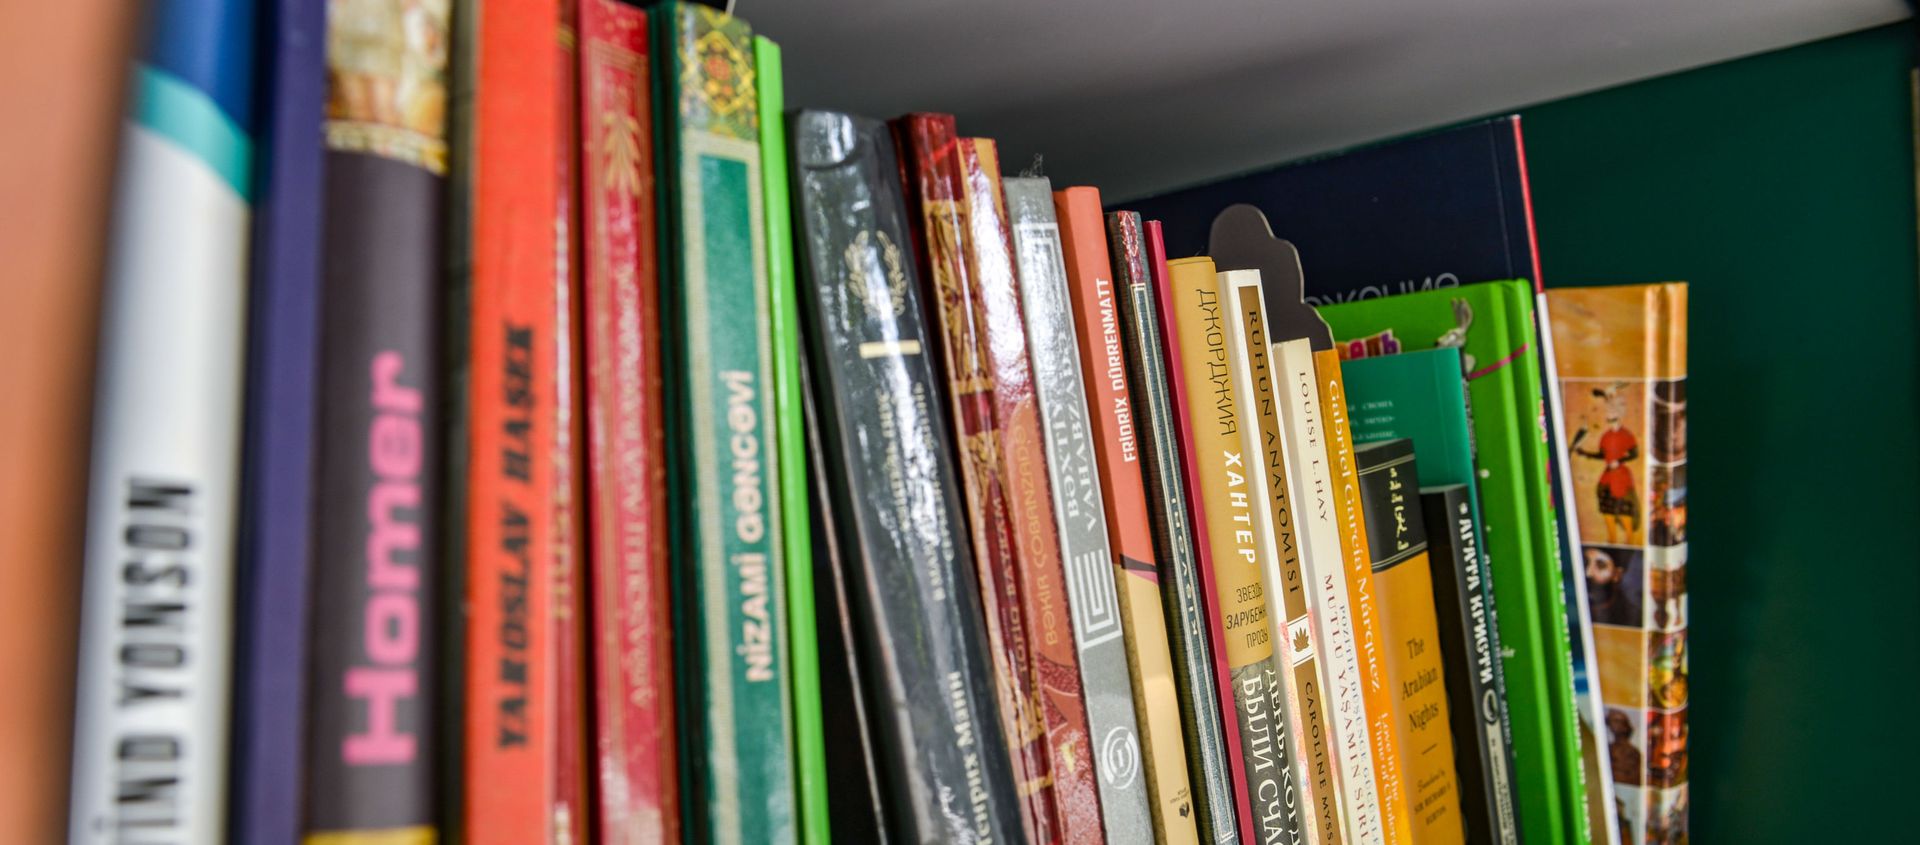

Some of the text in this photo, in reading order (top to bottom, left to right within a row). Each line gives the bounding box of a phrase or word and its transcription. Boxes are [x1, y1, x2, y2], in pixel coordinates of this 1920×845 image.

[1096, 278, 1124, 391] DÜRRENMATT
[1196, 289, 1256, 564] ДЖОРДЖИЯ ХАНТЕР
[1247, 310, 1299, 593] RUHUN ANATOMİSİ
[1299, 372, 1317, 448] LOUISE
[343, 350, 422, 765] Homer
[1328, 380, 1352, 479] Gabriel
[1357, 576, 1380, 694] Márquez
[1458, 517, 1494, 684] АГАТА КРИСТИ
[92, 476, 194, 845] İND YONSON
[496, 505, 531, 750] YAROSLAV
[731, 552, 773, 682] NİZAMİ
[1402, 666, 1438, 701] Arabian
[1406, 636, 1424, 659] The
[1243, 674, 1285, 845] БЫЛИ СЧА
[1305, 681, 1327, 789] CAROLINE
[1324, 574, 1343, 658] MUTLU
[1354, 787, 1369, 845] SIRL
[1375, 720, 1385, 761] Time
[1380, 713, 1392, 753] Love
[1390, 773, 1399, 800] the
[1408, 702, 1439, 733] Nights
